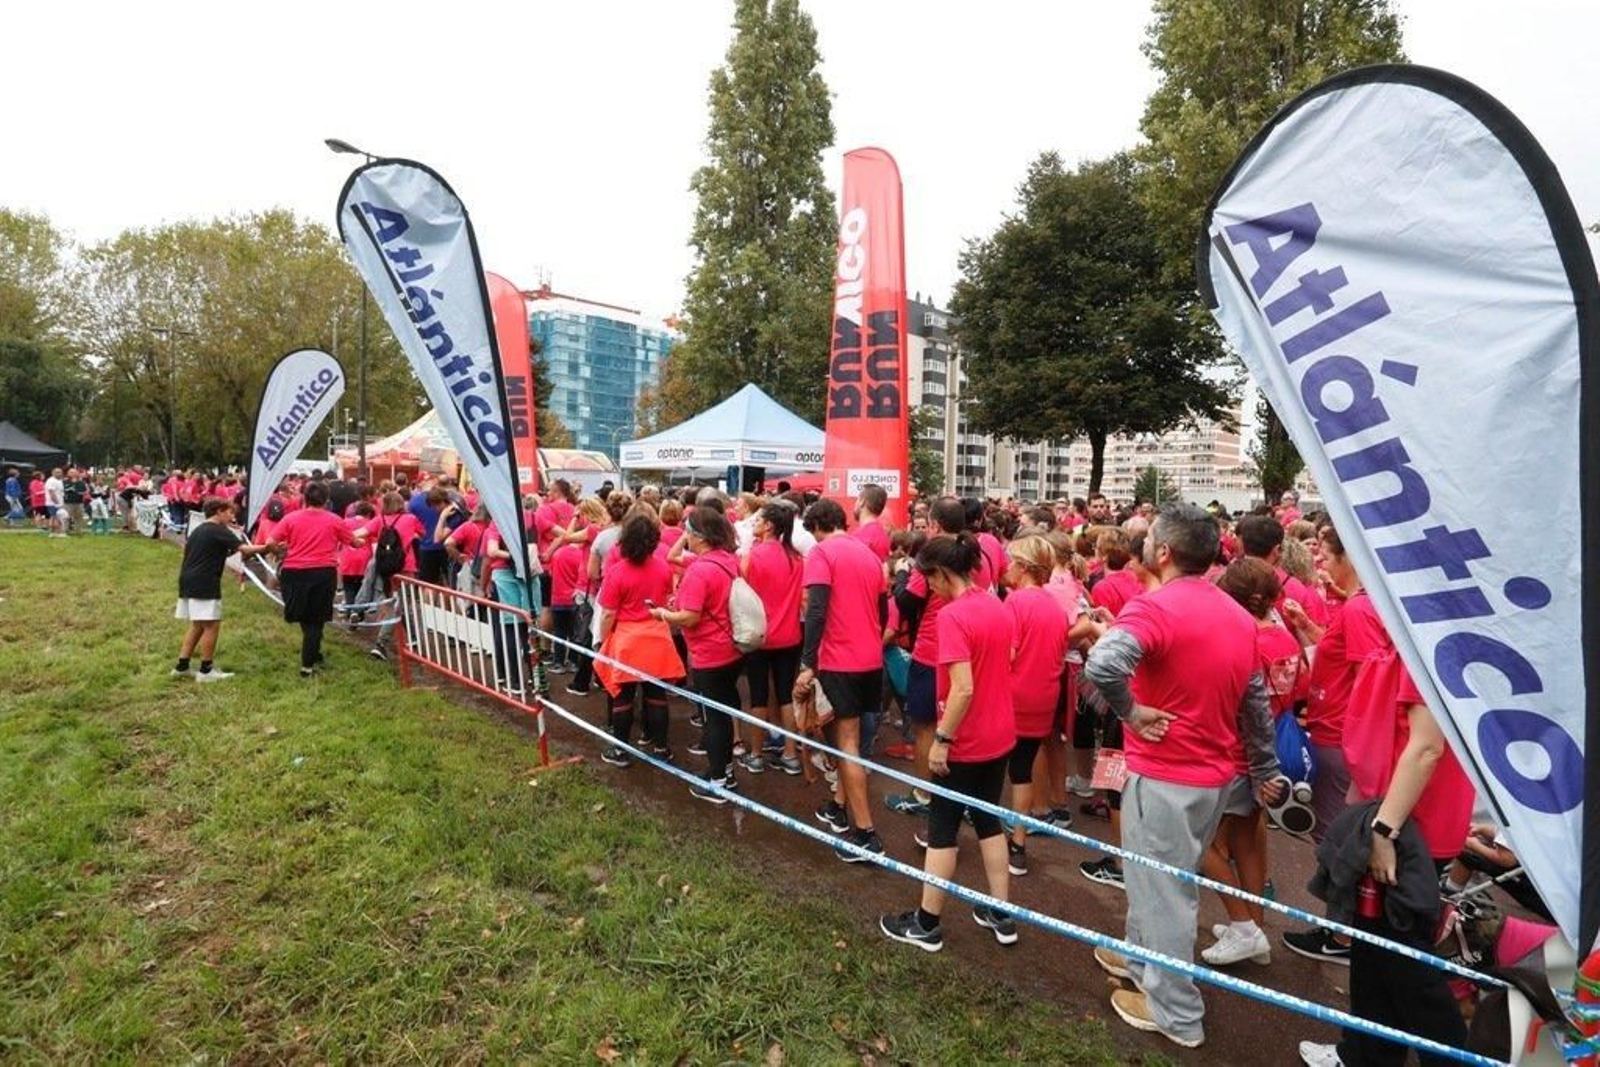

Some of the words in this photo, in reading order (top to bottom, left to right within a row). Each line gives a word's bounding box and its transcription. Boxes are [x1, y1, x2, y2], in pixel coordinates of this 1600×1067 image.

[256, 368, 334, 468] Atlántico
[361, 201, 507, 456] Atlántico
[1225, 203, 1585, 814] Atlántico
